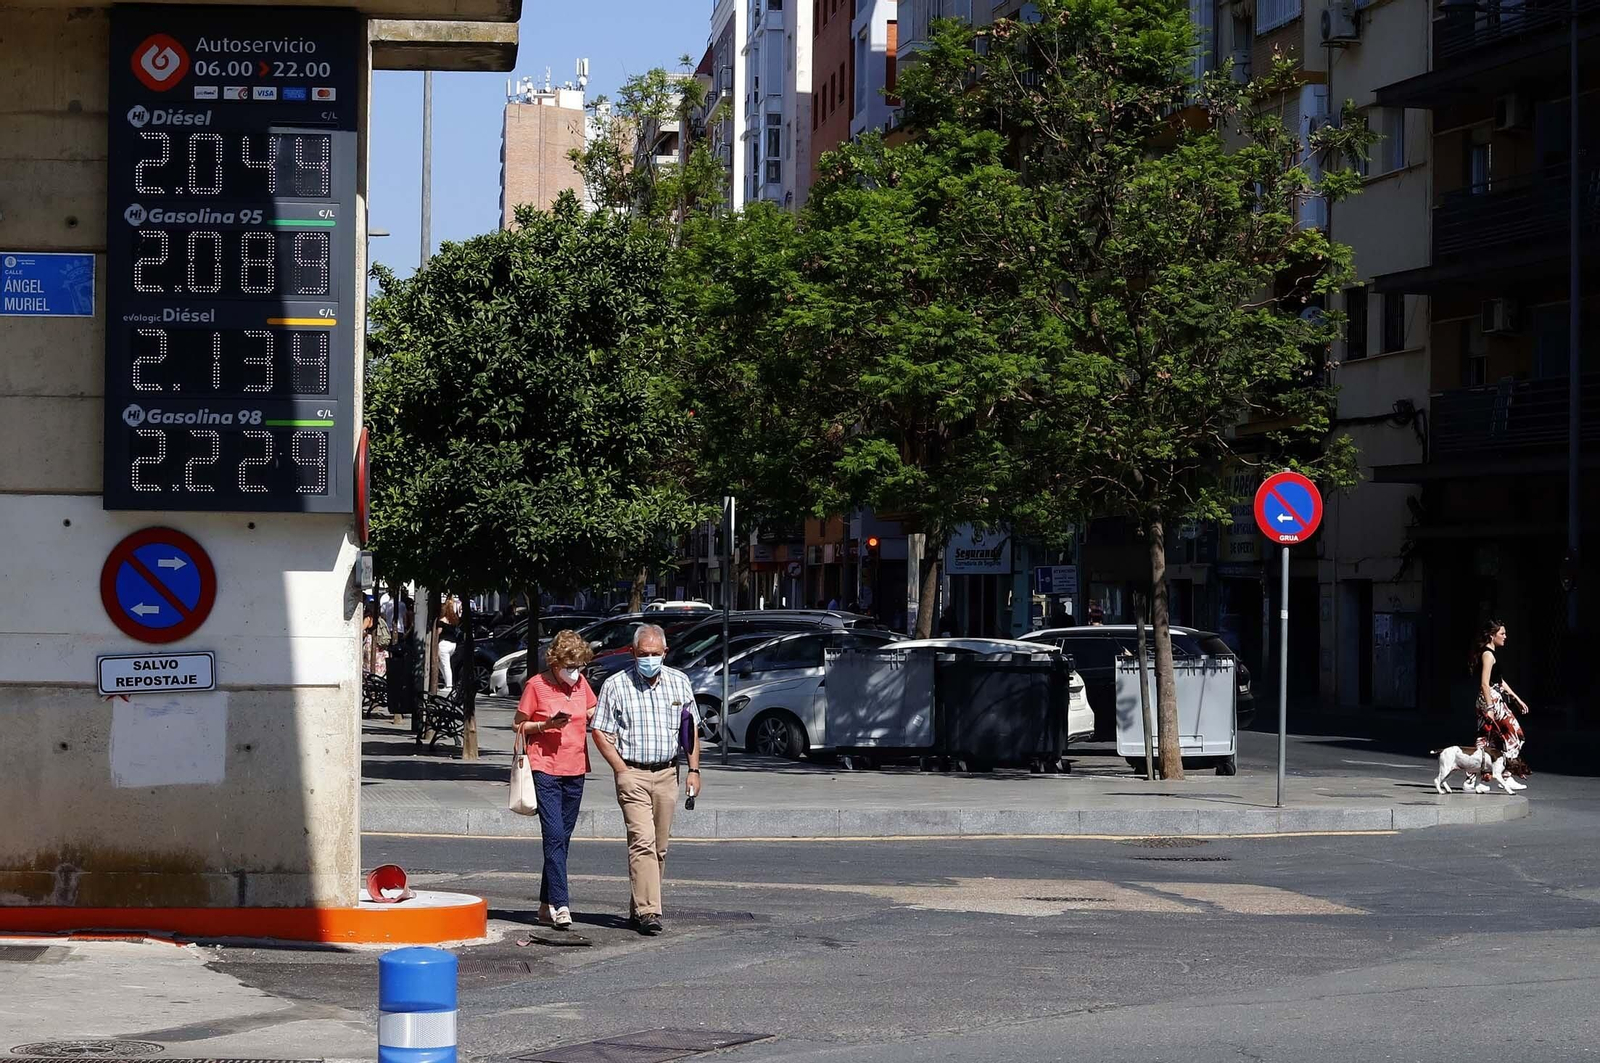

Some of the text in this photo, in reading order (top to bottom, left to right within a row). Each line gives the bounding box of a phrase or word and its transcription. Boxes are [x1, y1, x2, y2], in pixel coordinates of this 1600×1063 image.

[196, 37, 316, 53] Autoservicio
[195, 61, 331, 78] 06.00 22.00
[151, 108, 213, 126] Diésel
[135, 132, 329, 195] 2.044
[148, 207, 235, 225] Gasolina
[239, 209, 263, 225] 95
[134, 230, 329, 294] 2.089
[4, 276, 45, 293] ÁNGEL
[4, 297, 50, 311] MURIEL
[163, 308, 215, 323] Diésel
[132, 329, 327, 392] 2.134
[147, 408, 233, 425] Gasolina
[238, 409, 262, 425] 98
[132, 429, 326, 493] 2.229
[133, 659, 179, 671] SALVO
[115, 674, 198, 688] REPOSTAJE
